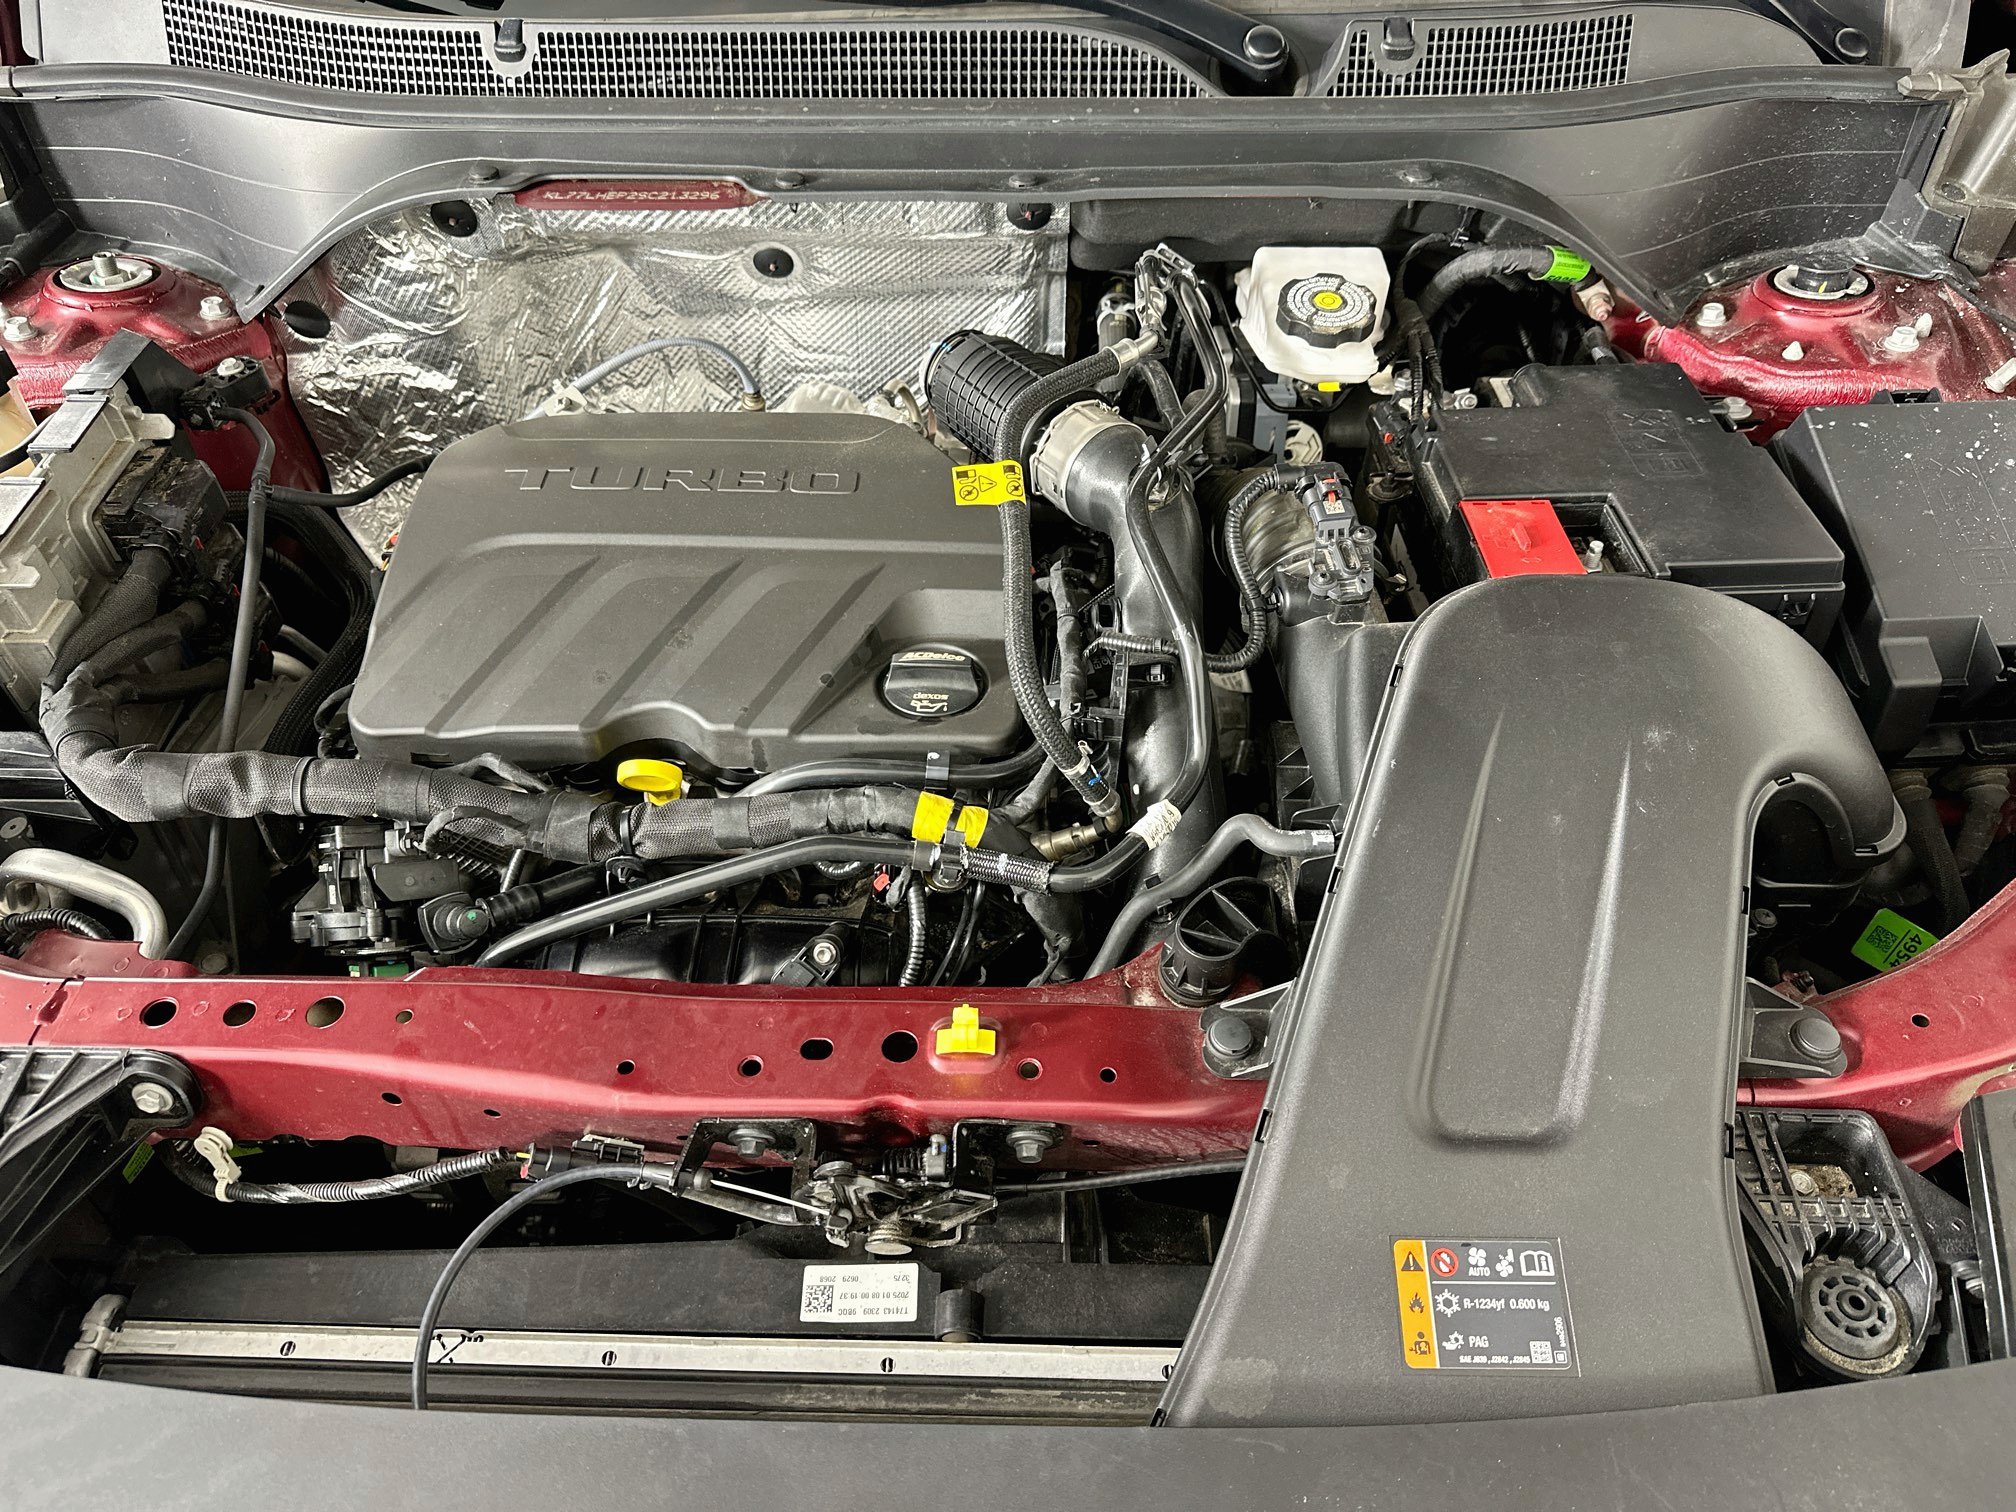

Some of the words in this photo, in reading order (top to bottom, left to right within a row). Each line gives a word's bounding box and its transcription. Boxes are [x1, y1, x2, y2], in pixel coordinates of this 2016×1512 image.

[504, 466, 861, 495] TURBO
[899, 652, 966, 661] ACDelco
[913, 692, 949, 700] dexos
[1468, 1266, 1490, 1277] AUTO
[893, 1274, 910, 1282] 3275
[1463, 1298, 1506, 1312] R-1234yf
[1509, 1298, 1536, 1310] 0.600
[1537, 1298, 1550, 1312] kg
[1468, 1335, 1489, 1348] PAG
